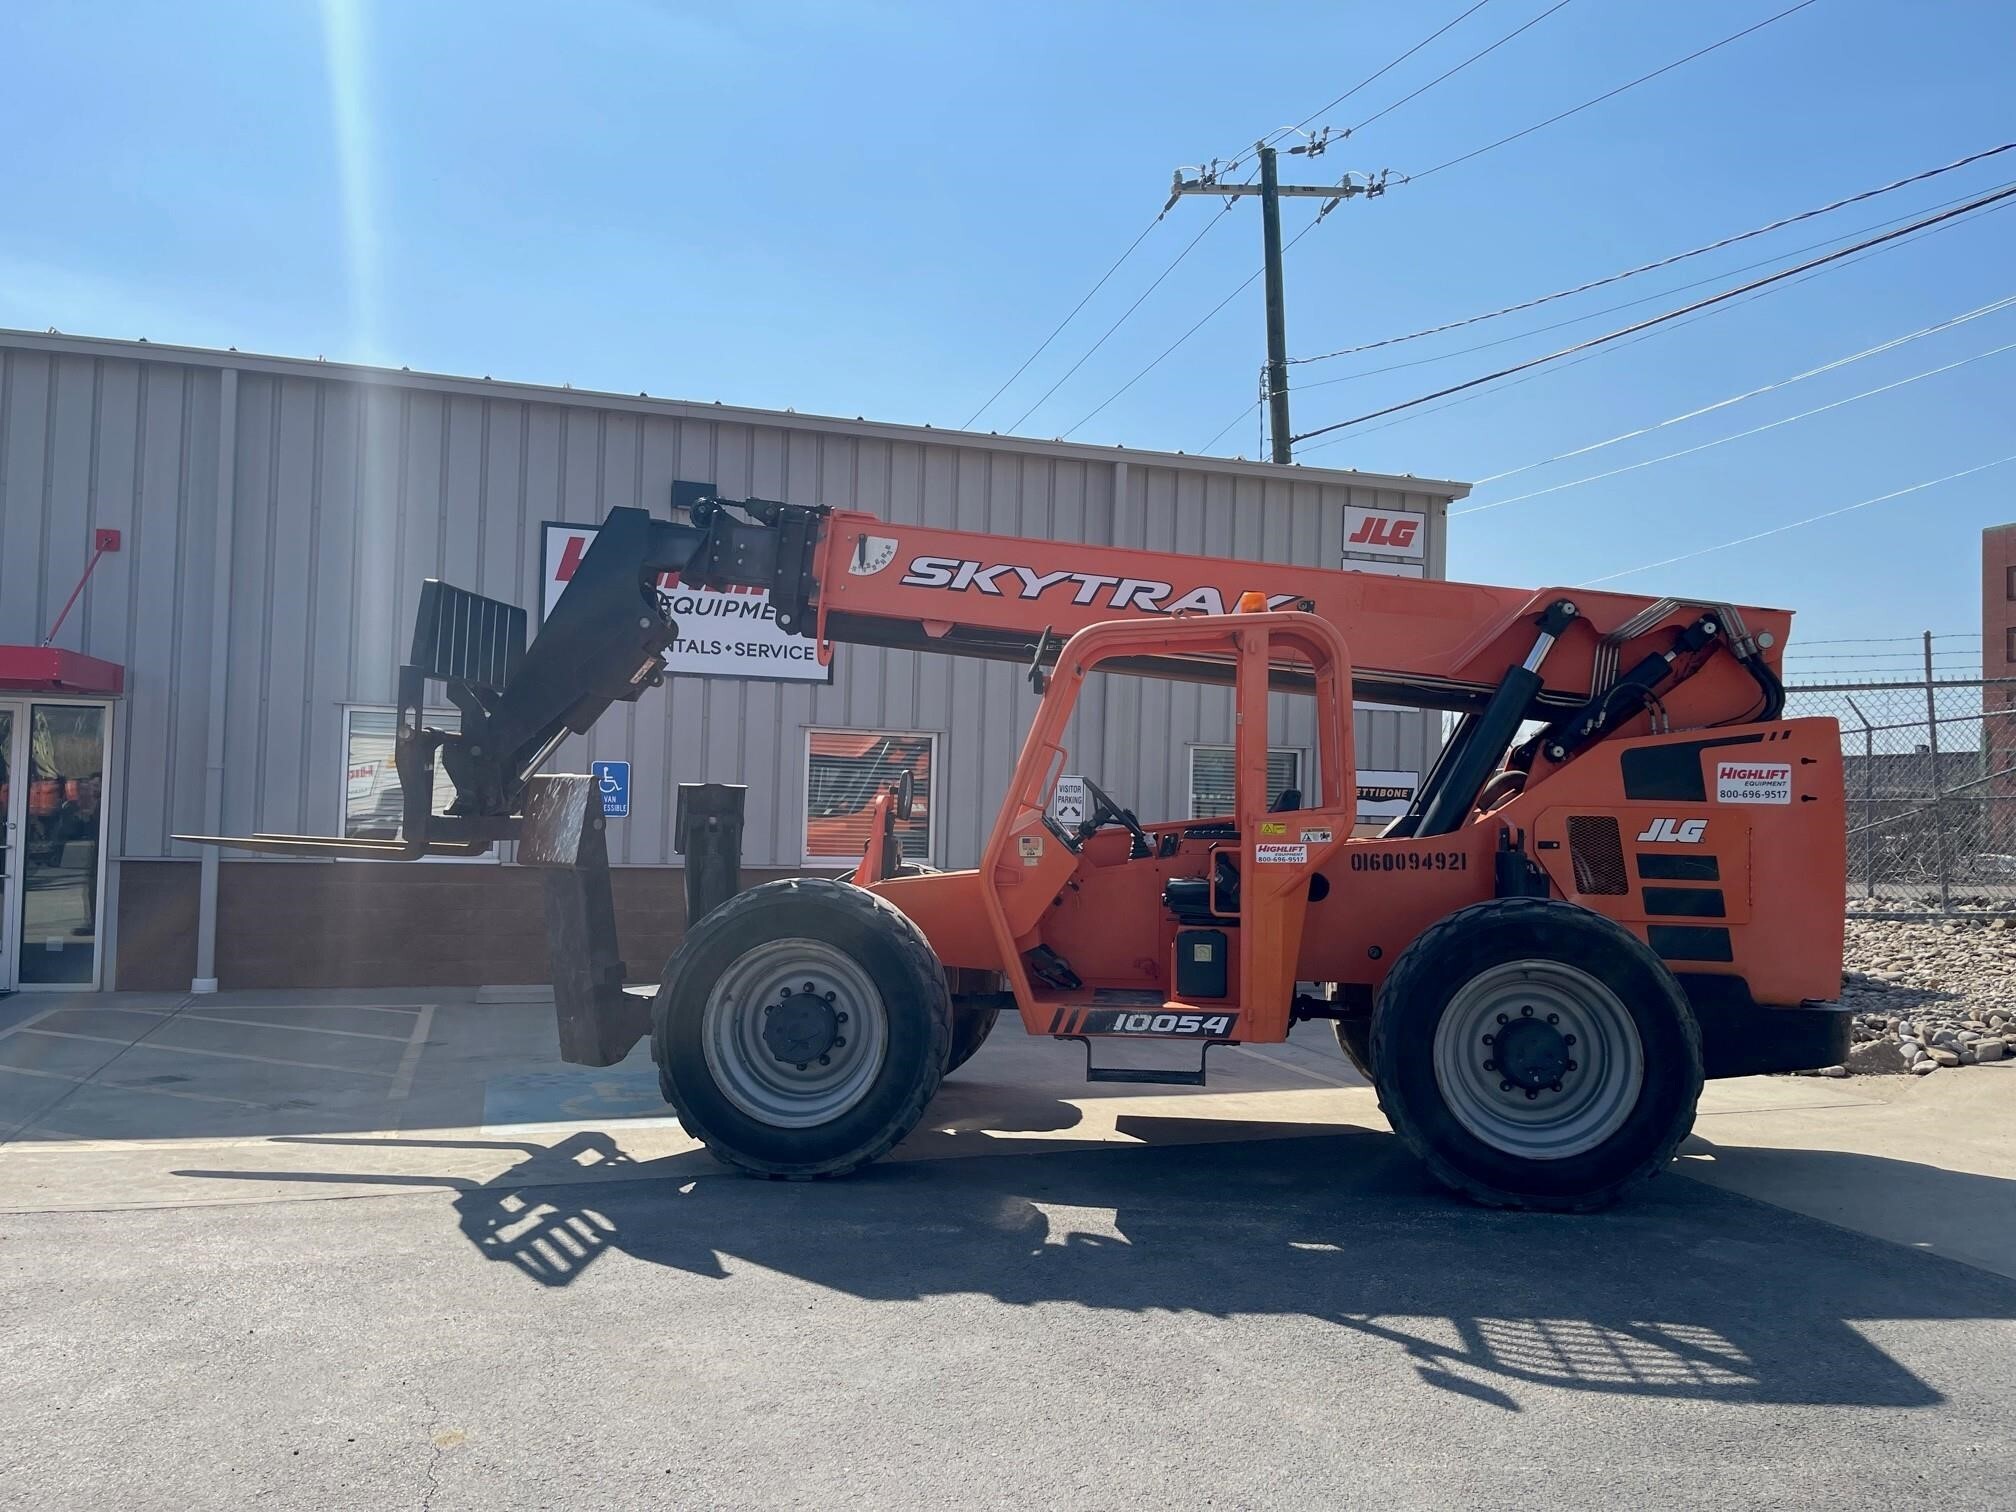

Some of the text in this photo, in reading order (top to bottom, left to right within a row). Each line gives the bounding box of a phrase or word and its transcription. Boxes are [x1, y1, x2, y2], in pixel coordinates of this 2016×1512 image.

[1349, 516, 1419, 548] JLG
[660, 596, 776, 621] EQUIPME
[734, 641, 815, 661] SERVICE
[1058, 784, 1082, 793] VISITOR
[1356, 787, 1409, 798] ETTIBONE
[1719, 789, 1788, 799] 800-696-9517
[603, 795, 617, 803] VAN
[1057, 795, 1083, 804] PARKING
[603, 804, 627, 812] ESSIBLE
[1636, 817, 1709, 843] JLG
[1351, 852, 1467, 871] 0160094921
[1113, 1013, 1229, 1034] 10054
